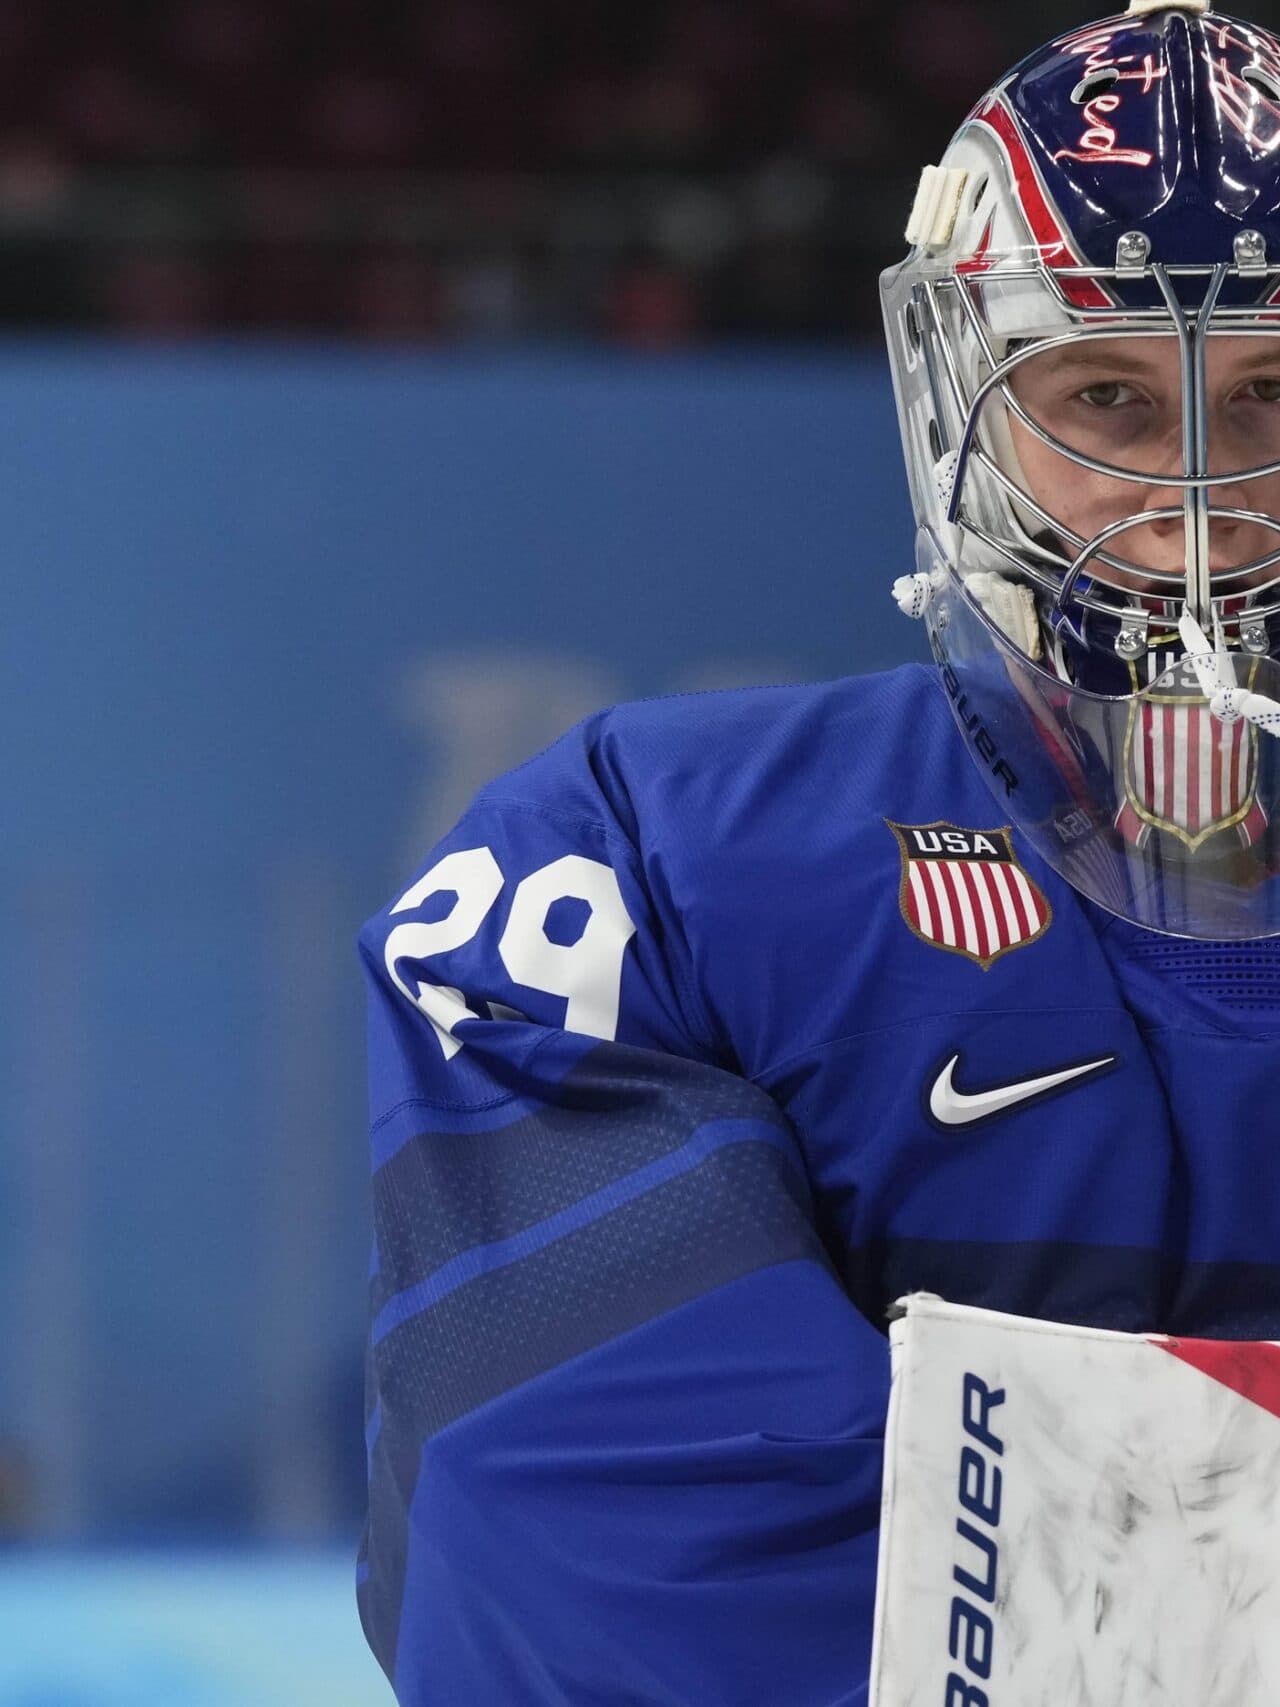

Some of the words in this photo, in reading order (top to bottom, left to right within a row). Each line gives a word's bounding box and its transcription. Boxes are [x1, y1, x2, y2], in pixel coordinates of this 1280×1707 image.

[1146, 651, 1202, 688] US
[912, 829, 999, 855] USA
[384, 845, 637, 1061] 29
